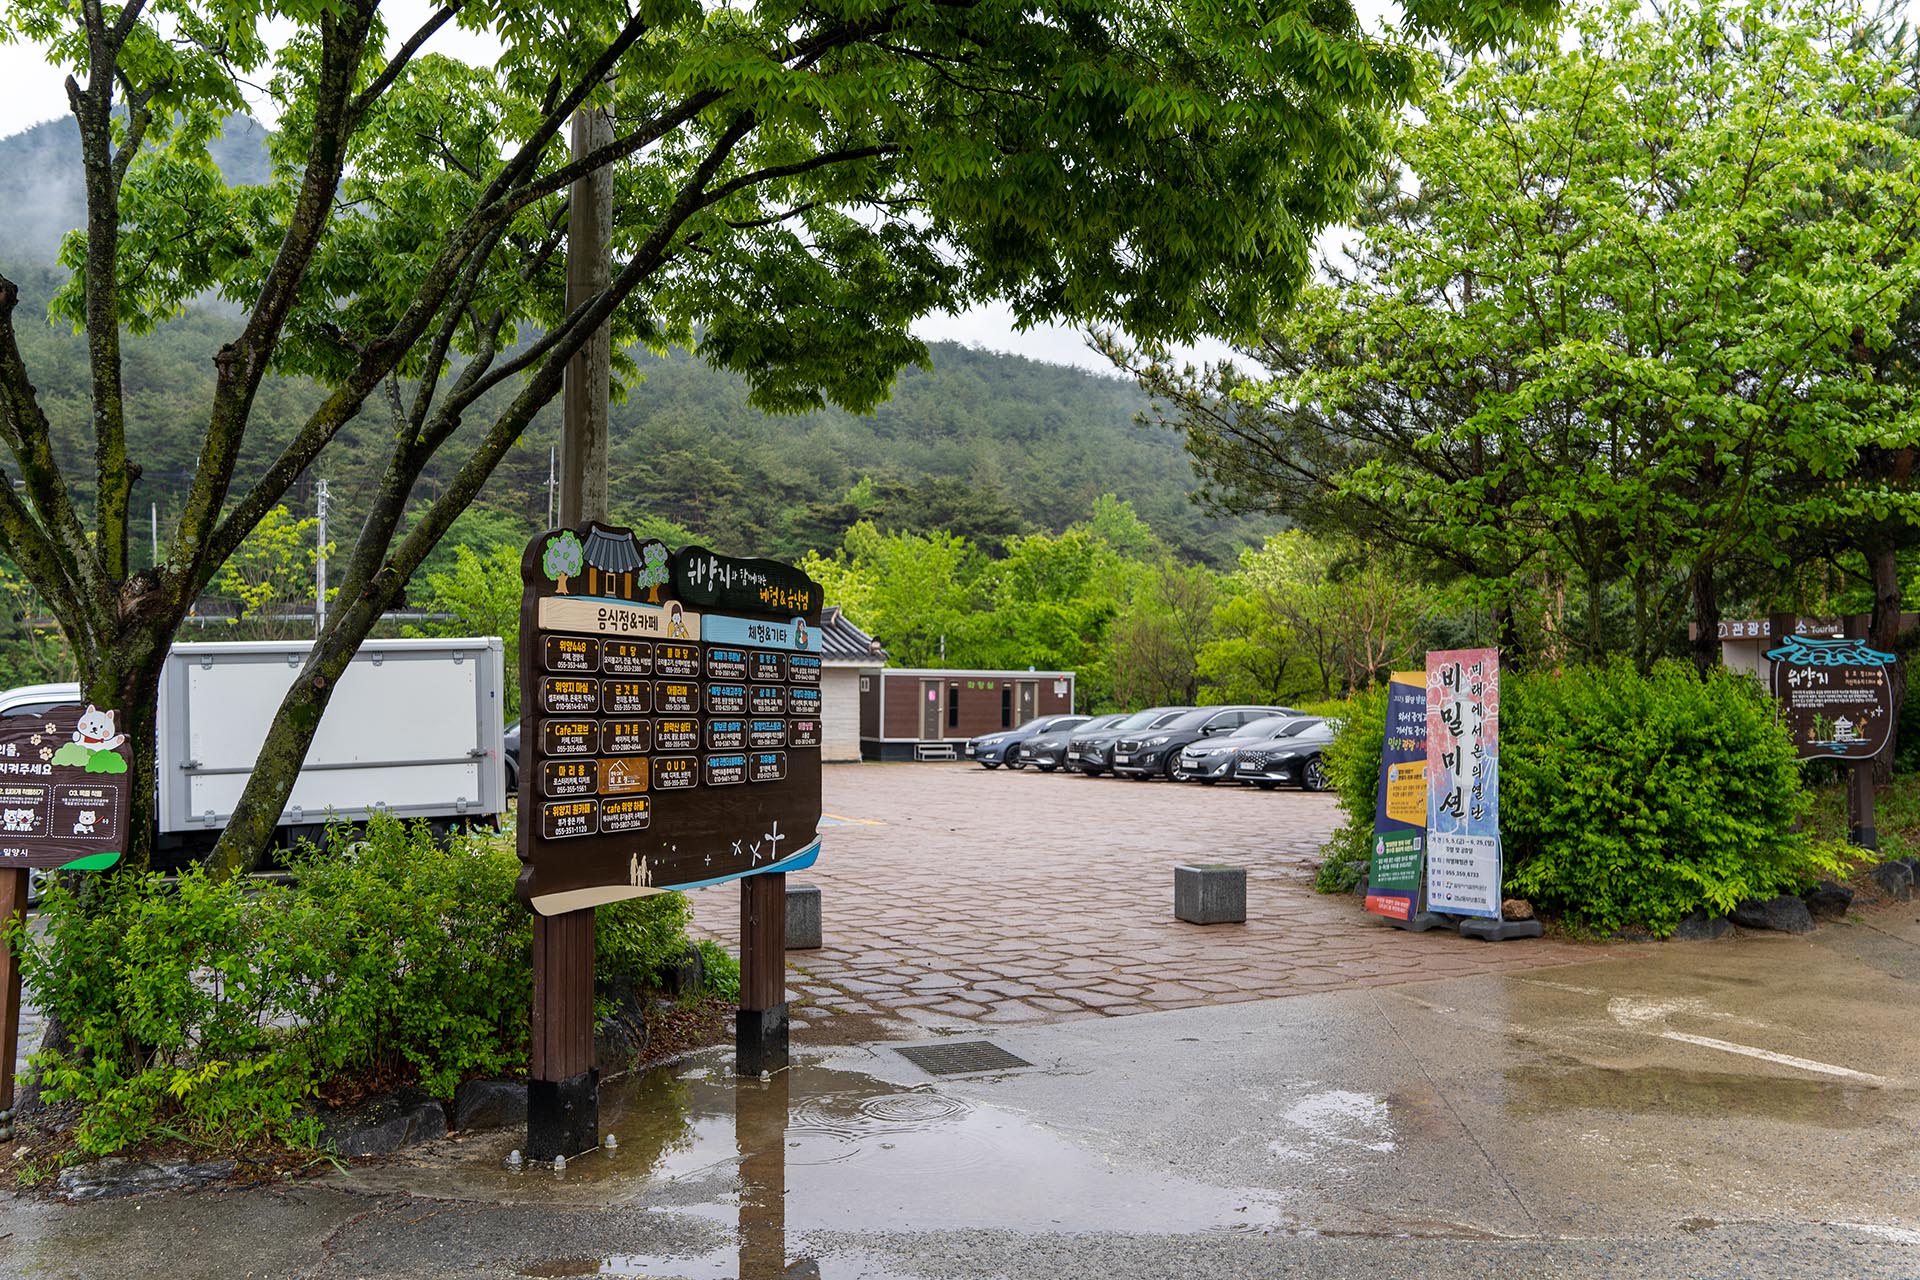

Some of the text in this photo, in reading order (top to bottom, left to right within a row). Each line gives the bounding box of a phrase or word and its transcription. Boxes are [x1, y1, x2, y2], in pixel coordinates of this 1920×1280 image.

[598, 608, 658, 632] 음식점&카페
[1811, 624, 1838, 634] Tourist
[559, 640, 587, 652] 위양448
[1787, 666, 1829, 688] 위양지
[555, 682, 574, 694] 위양지
[552, 804, 571, 817] 위양지
[3, 848, 28, 857] 밀양시
